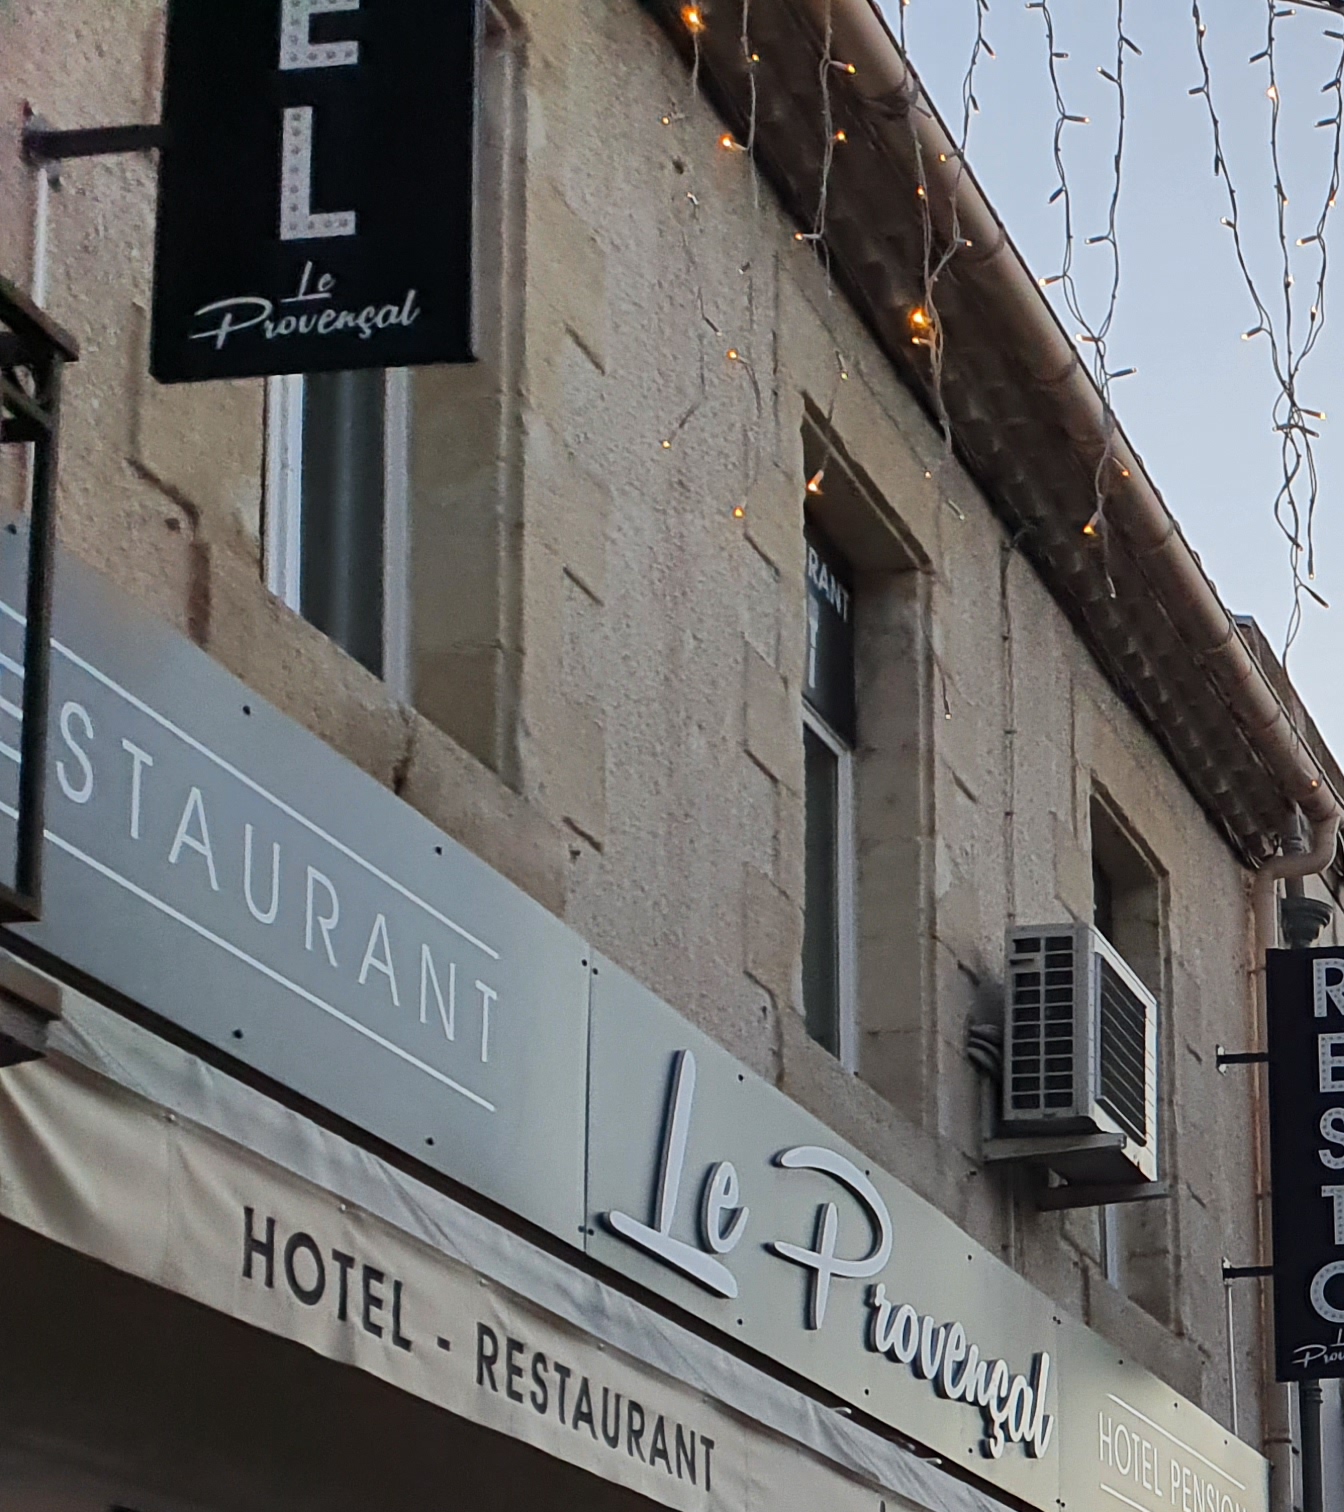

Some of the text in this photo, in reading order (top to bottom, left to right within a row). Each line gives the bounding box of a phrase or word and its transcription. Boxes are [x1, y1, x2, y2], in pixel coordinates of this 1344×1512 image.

[189, 288, 420, 350] Provençal
[281, 260, 336, 302] Le
[606, 1048, 749, 1299] Le
[242, 1205, 412, 1354] HOTEL
[475, 1321, 716, 1493] RESTAURANT
[769, 1145, 1055, 1460] Provençal
[1098, 1410, 1163, 1498] HOTEL
